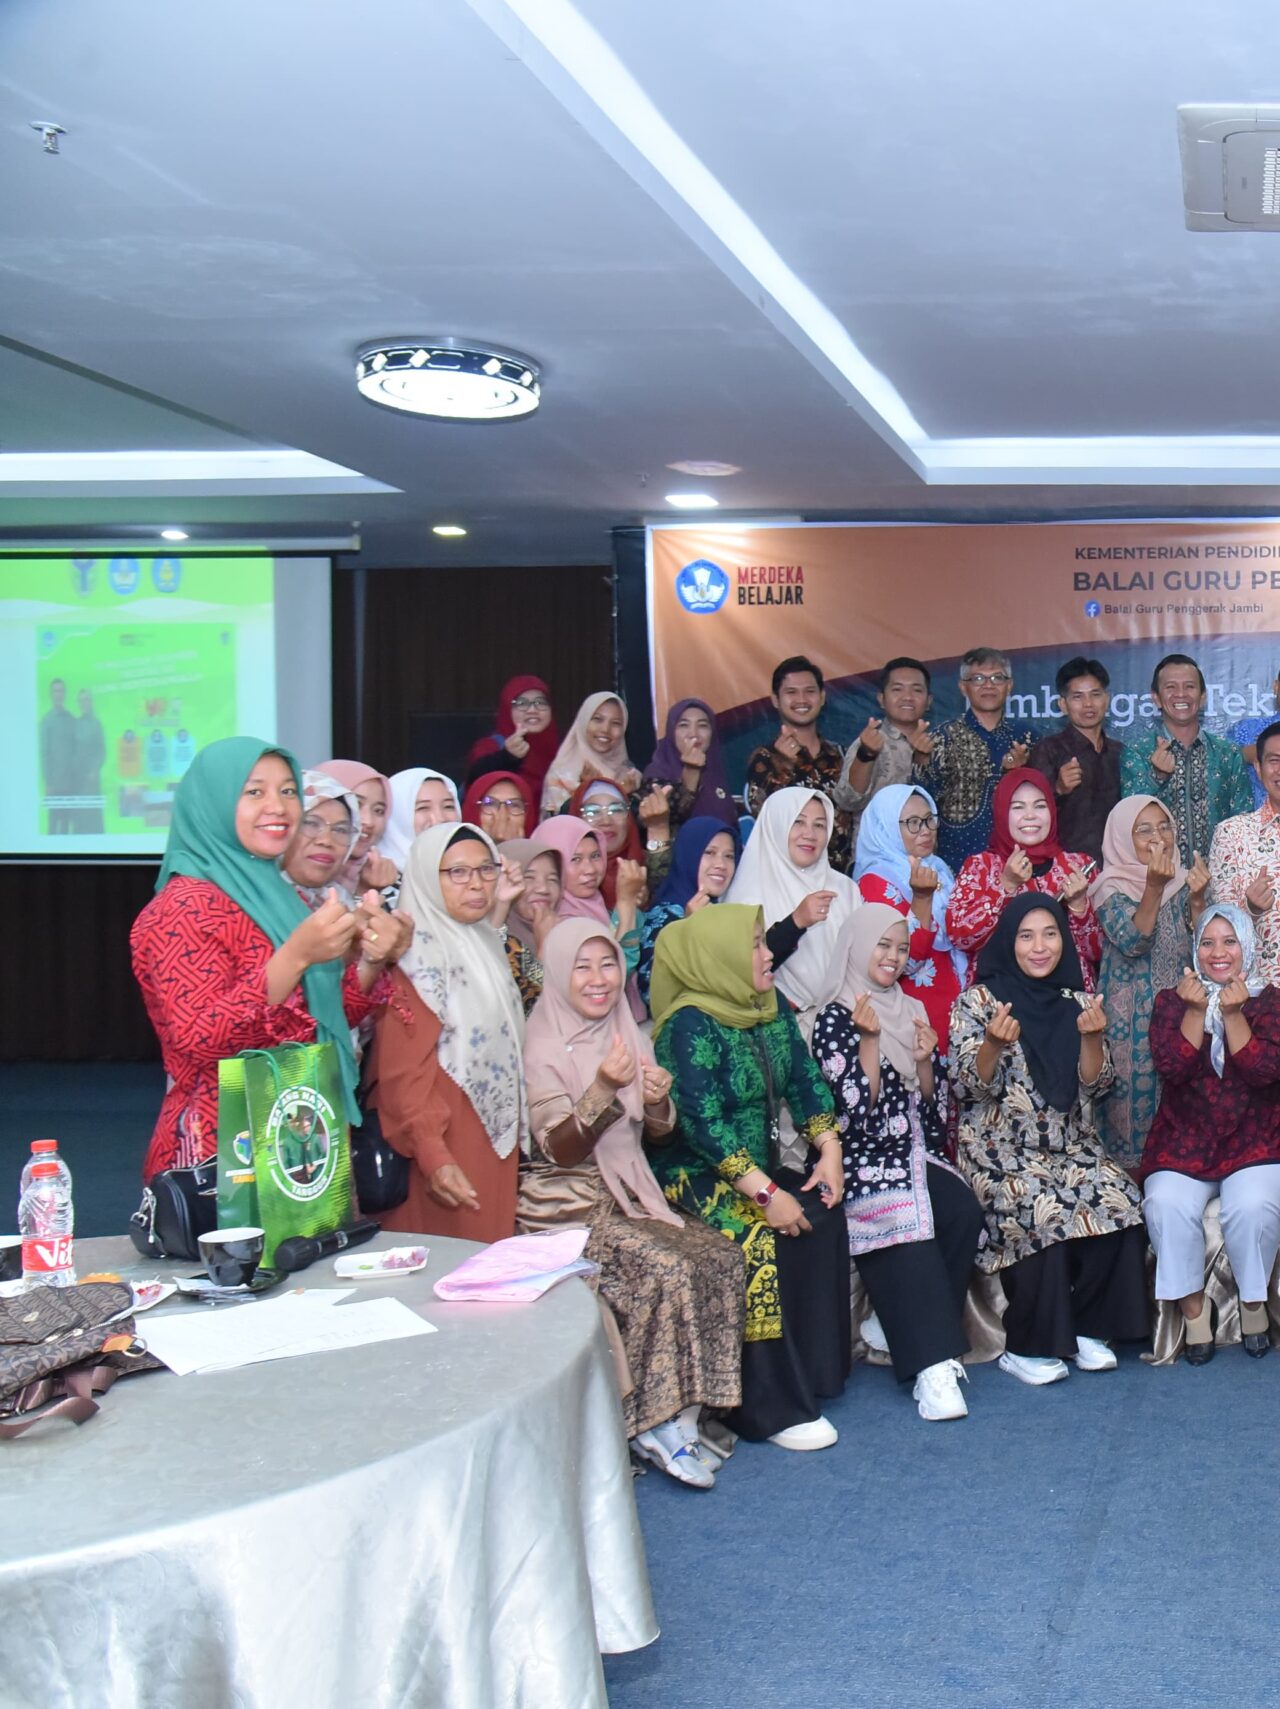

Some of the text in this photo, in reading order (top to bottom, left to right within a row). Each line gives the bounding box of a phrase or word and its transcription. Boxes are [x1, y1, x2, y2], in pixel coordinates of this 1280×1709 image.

[1075, 546, 1199, 560] KEMENTERIAN
[737, 566, 804, 584] MERDEKA
[1073, 571, 1154, 591] BALAI
[1163, 570, 1241, 591] GURU
[738, 585, 804, 605] BELAJAR
[1104, 602, 1264, 616] Balai Guru Penggerak Jambi
